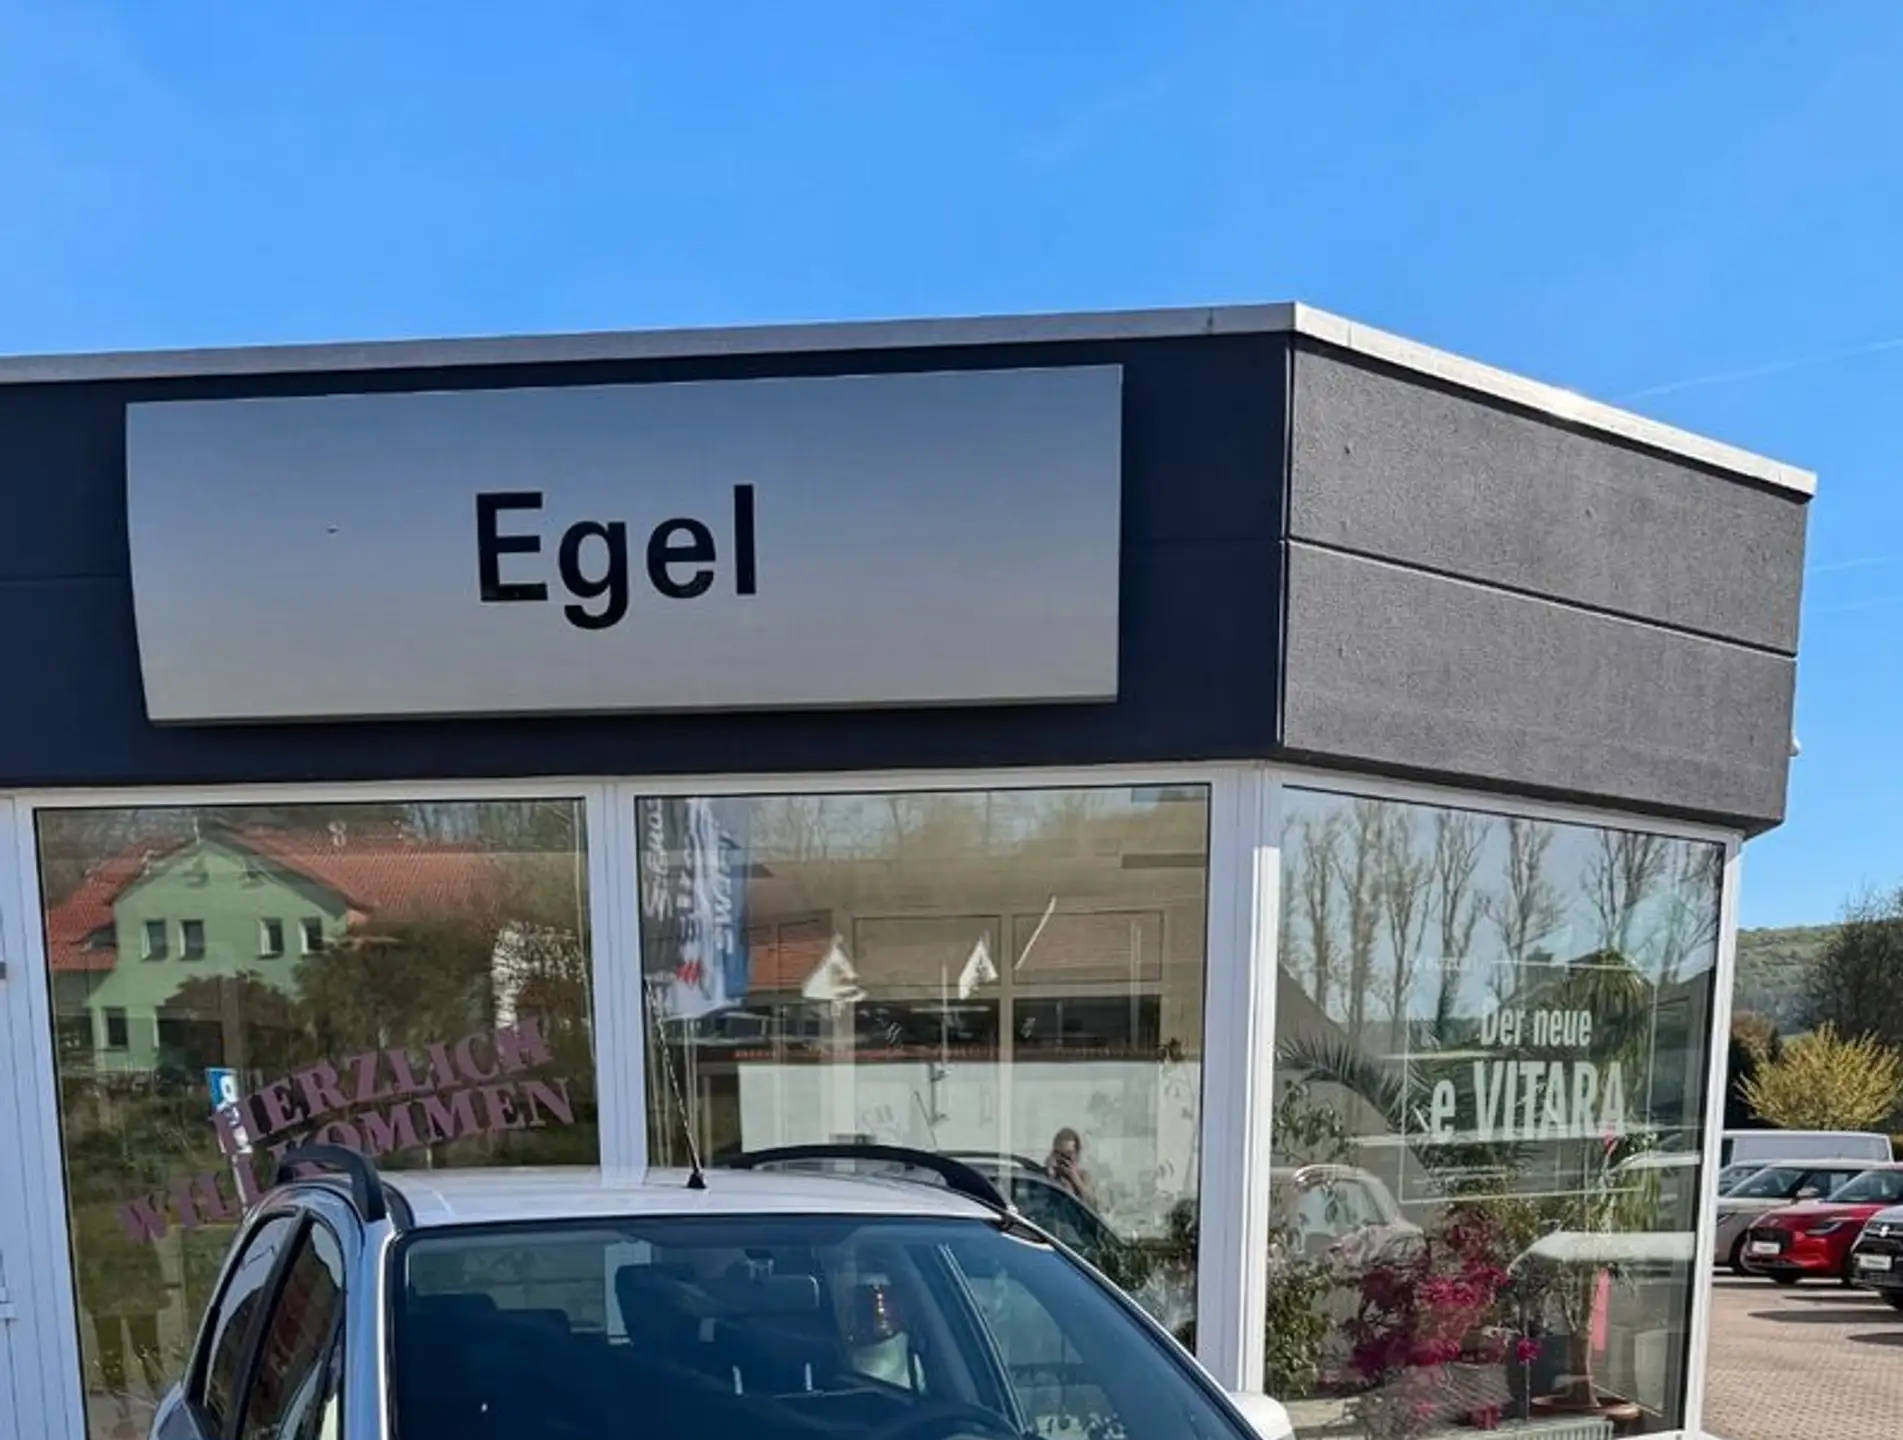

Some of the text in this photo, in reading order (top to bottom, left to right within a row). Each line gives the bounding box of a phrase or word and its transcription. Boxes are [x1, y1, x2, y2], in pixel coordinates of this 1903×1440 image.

[476, 483, 756, 630] Egel
[1481, 1007, 1593, 1046] Der neue
[211, 1015, 553, 1155] HERZLICH
[1430, 1061, 1625, 1141] e VITARA
